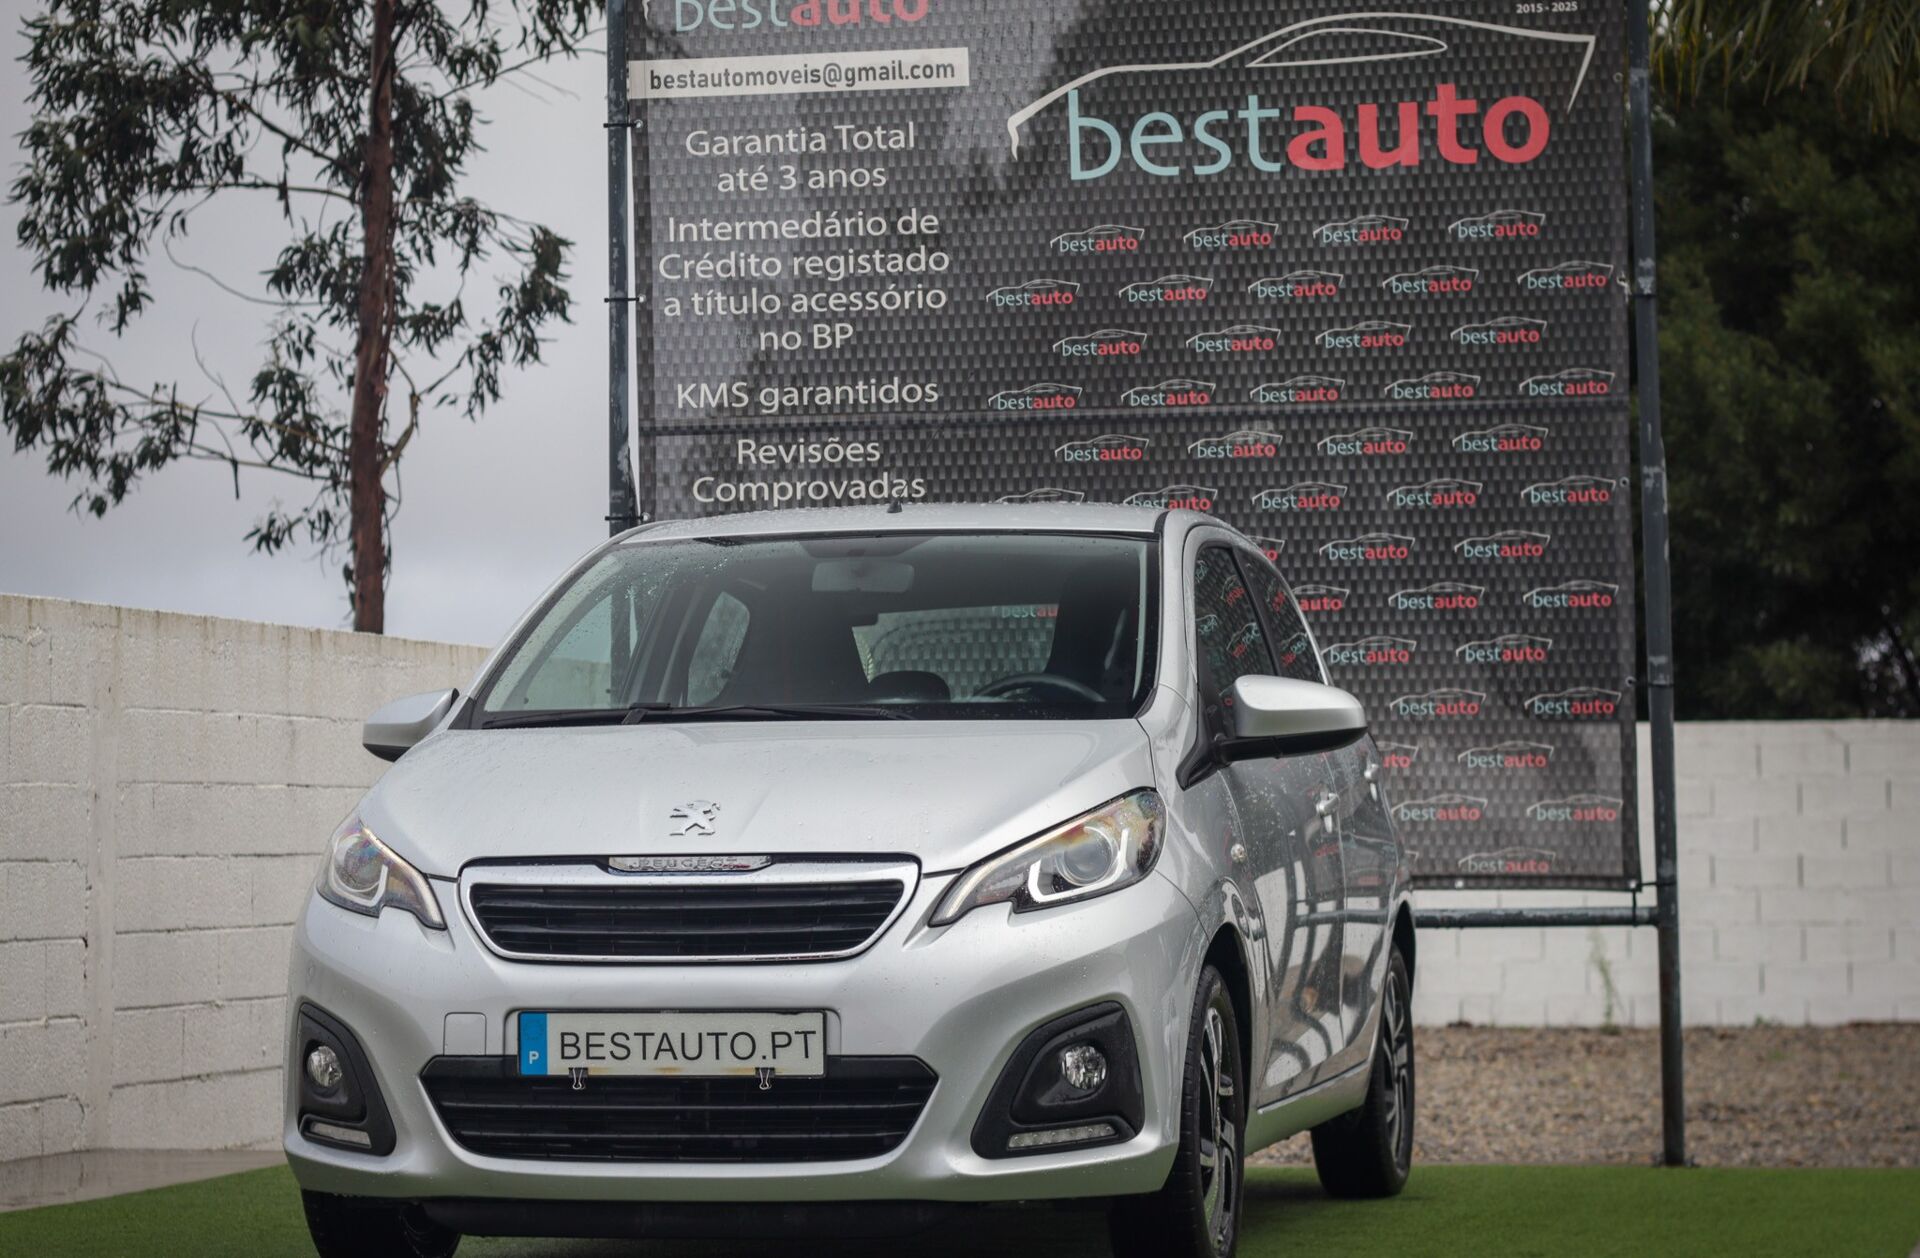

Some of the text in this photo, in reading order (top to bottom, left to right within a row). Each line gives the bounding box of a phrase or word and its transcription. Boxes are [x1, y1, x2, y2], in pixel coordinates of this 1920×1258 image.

[1516, 3, 1543, 14] 2015
[1551, 1, 1578, 12] 2025
[650, 60, 955, 90] bestautomoveis@gmail.com
[685, 121, 915, 156] Garantia Total
[1067, 83, 1550, 181] bestauto
[717, 165, 887, 193] até 3 anos
[668, 208, 939, 242] Intermedário de
[1458, 222, 1539, 238] bestauto
[1191, 232, 1272, 247] bestauto
[1322, 226, 1403, 242] bestauto
[1059, 235, 1138, 252] bestauto
[659, 245, 949, 281] Crédito registado
[1391, 277, 1472, 294] bestauto
[1527, 272, 1608, 289] bestauto
[994, 291, 1073, 306] bestauto
[1127, 288, 1207, 302] bestauto
[1256, 283, 1337, 298] bestauto
[663, 284, 947, 316] a título acessório
[759, 324, 853, 350] no BP
[1195, 337, 1275, 352] bestauto
[1324, 332, 1404, 349] bestauto
[1460, 329, 1540, 345] bestauto
[1061, 342, 1140, 357] bestauto
[677, 377, 939, 413] KMS garantidos
[1259, 387, 1339, 402] bestauto
[1394, 384, 1475, 399] bestauto
[1528, 381, 1608, 398] bestauto
[996, 395, 1076, 411] bestauto
[1129, 391, 1209, 407] bestauto
[738, 437, 880, 464] Revisões
[1197, 443, 1276, 459] bestauto
[1326, 440, 1406, 455] bestauto
[1461, 436, 1542, 452] bestauto
[1063, 447, 1143, 462] bestauto
[693, 472, 926, 506] Comprovadas
[1531, 487, 1610, 503] bestauto
[1260, 495, 1340, 510] bestauto
[1396, 491, 1476, 507] bestauto
[1328, 544, 1408, 561] bestauto
[1463, 543, 1543, 558] bestauto
[1300, 597, 1342, 611] auto
[1397, 595, 1478, 610] bestauto
[1531, 593, 1612, 609] bestauto
[1330, 648, 1409, 664] bestauto
[1465, 647, 1546, 662] bestauto
[1399, 701, 1480, 716] bestauto
[1534, 699, 1615, 715] bestauto
[1468, 752, 1546, 768] bestauto
[1401, 805, 1480, 821] bestauto
[1537, 805, 1616, 821] bestauto
[560, 1031, 816, 1061] BESTAUTO.PT
[529, 1051, 539, 1064] P
